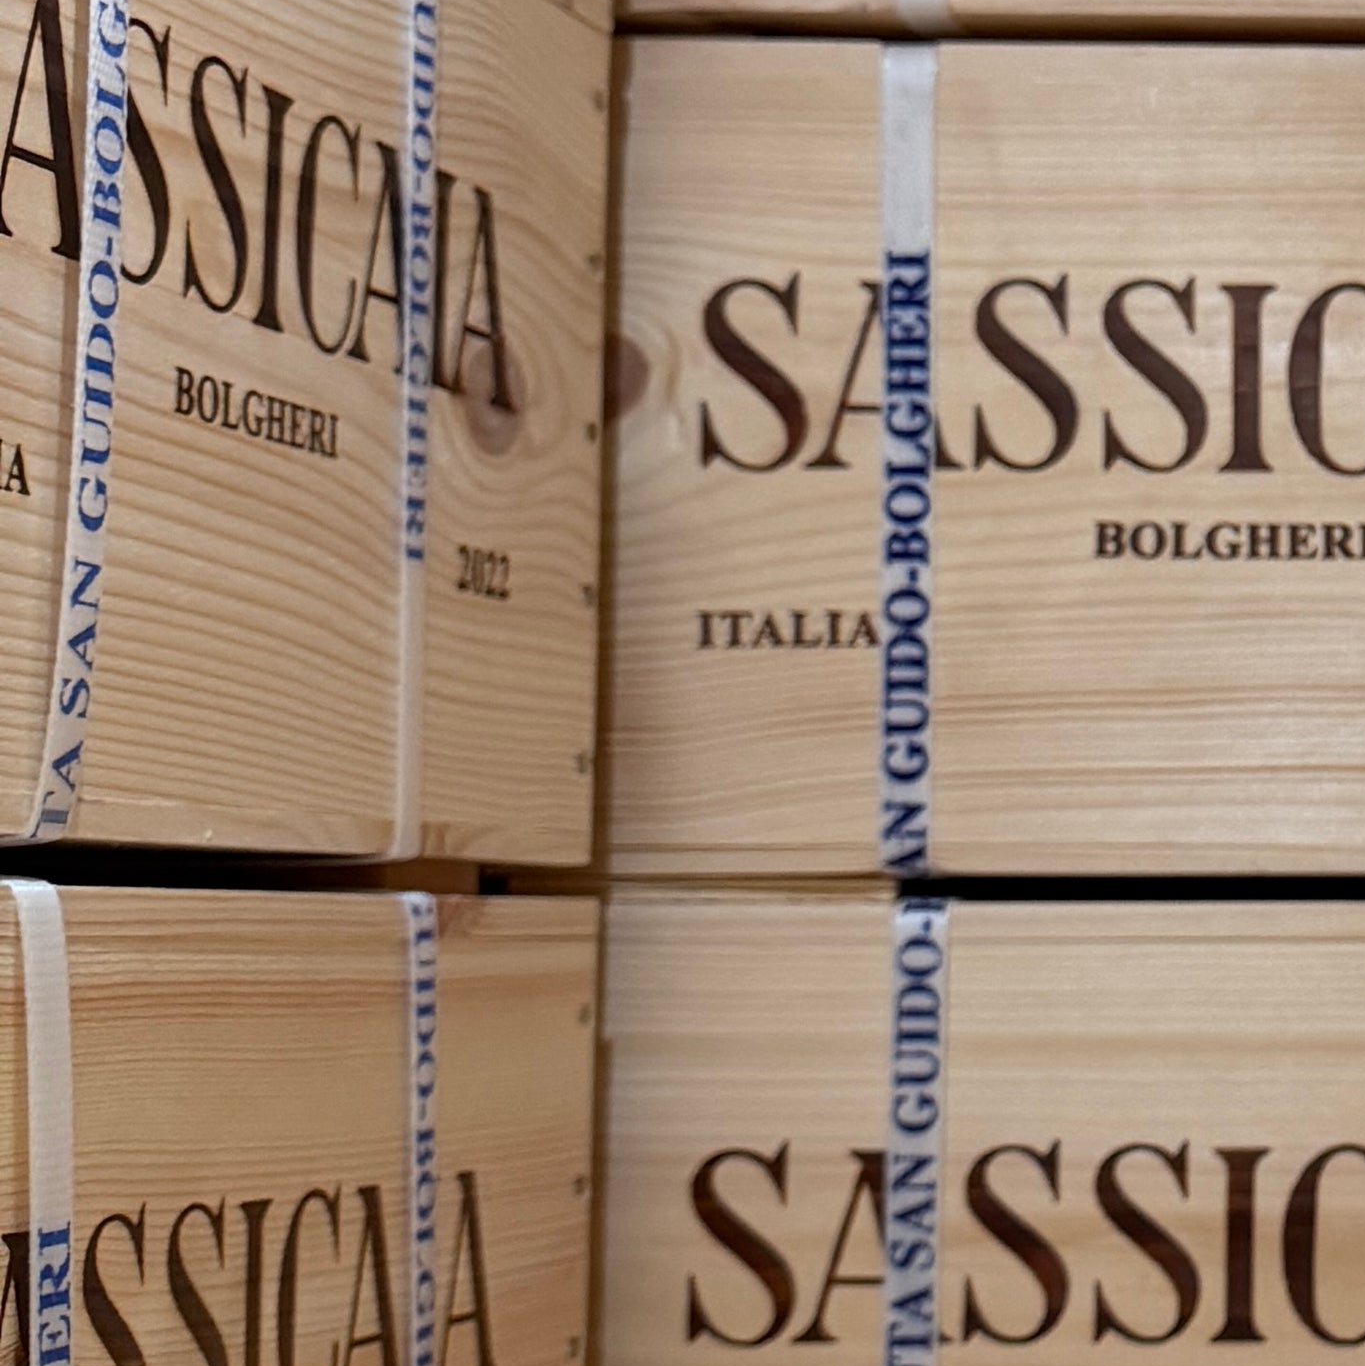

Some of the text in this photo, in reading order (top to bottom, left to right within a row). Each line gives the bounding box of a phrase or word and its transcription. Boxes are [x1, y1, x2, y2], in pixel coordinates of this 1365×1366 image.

[174, 367, 339, 459] BOLGHERI
[883, 250, 932, 782] GUIDO-BOLGHERI
[456, 545, 511, 600] 2022
[58, 556, 104, 722] SAN
[697, 609, 881, 650] ITALIA
[888, 1152, 939, 1276] SAN
